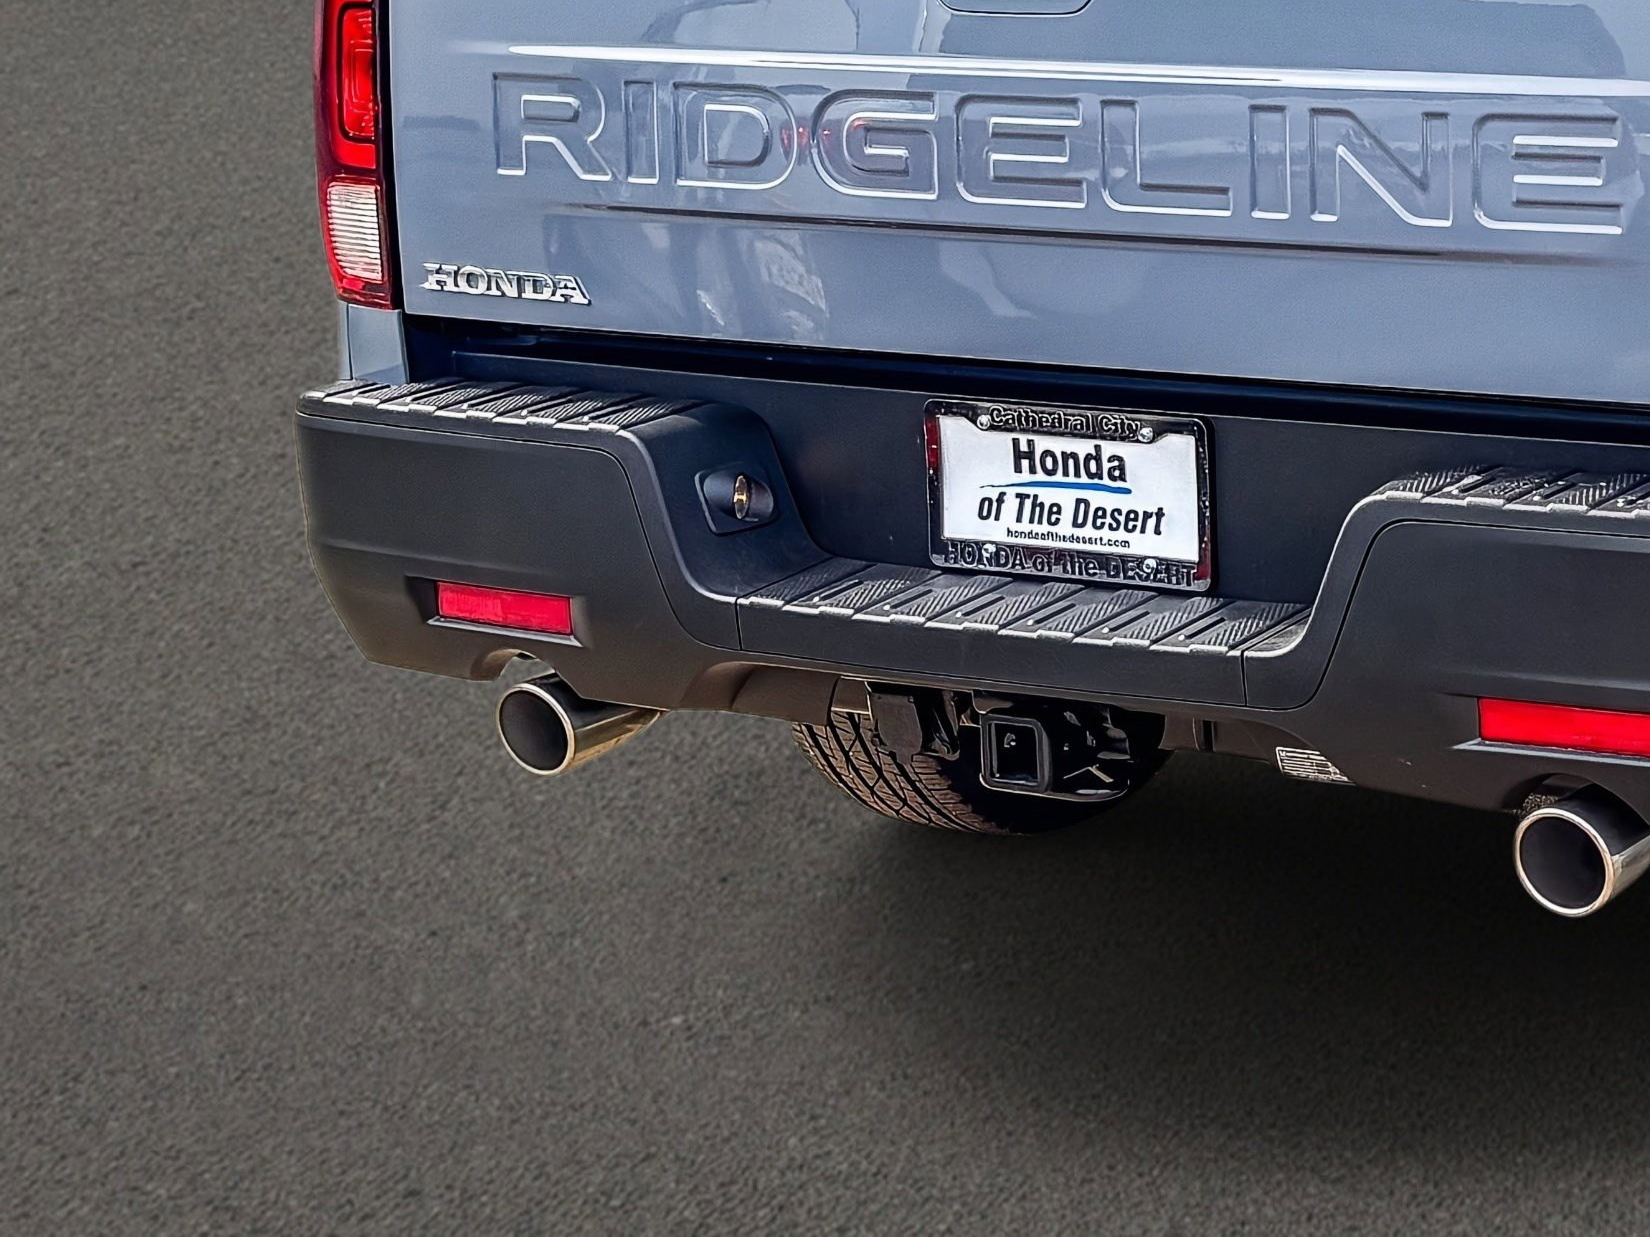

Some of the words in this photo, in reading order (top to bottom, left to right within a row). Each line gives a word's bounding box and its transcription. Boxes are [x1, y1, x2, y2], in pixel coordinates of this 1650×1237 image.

[492, 72, 1623, 235] RIDGELINE
[420, 262, 593, 306] HONDA
[989, 405, 1093, 433] Cathedral
[1098, 414, 1140, 441] City
[1011, 437, 1128, 483] Honda
[977, 491, 1007, 522] of
[1015, 493, 1062, 528] The
[1071, 497, 1166, 536] Desert
[1061, 550, 1100, 577] the
